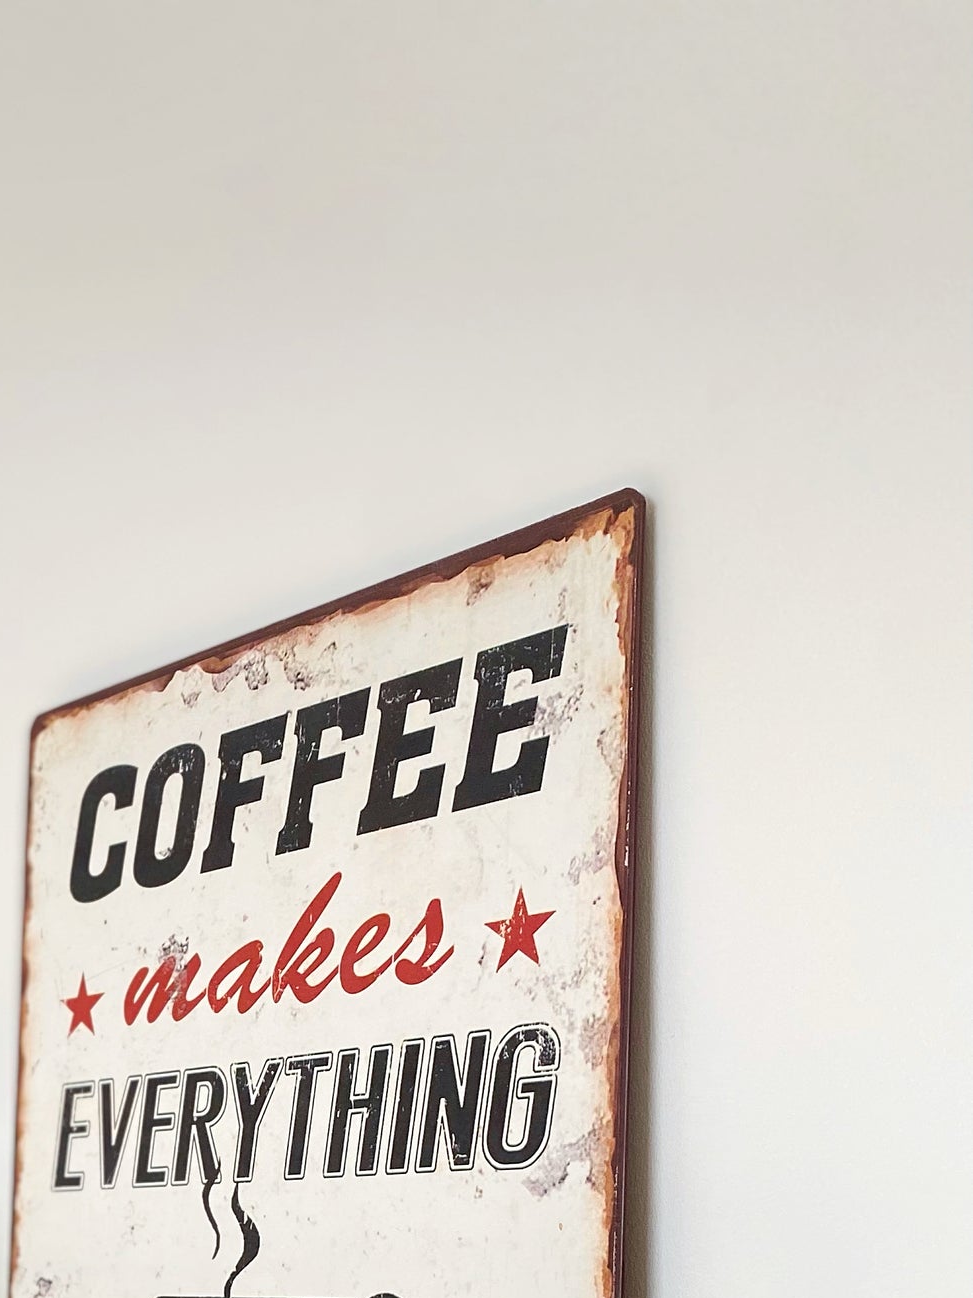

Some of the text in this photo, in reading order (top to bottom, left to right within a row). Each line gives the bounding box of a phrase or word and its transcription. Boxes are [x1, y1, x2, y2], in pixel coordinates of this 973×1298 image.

[69, 624, 569, 904] COFFEE
[123, 871, 454, 1026] makes
[50, 1021, 562, 1193] EVERYTHING
